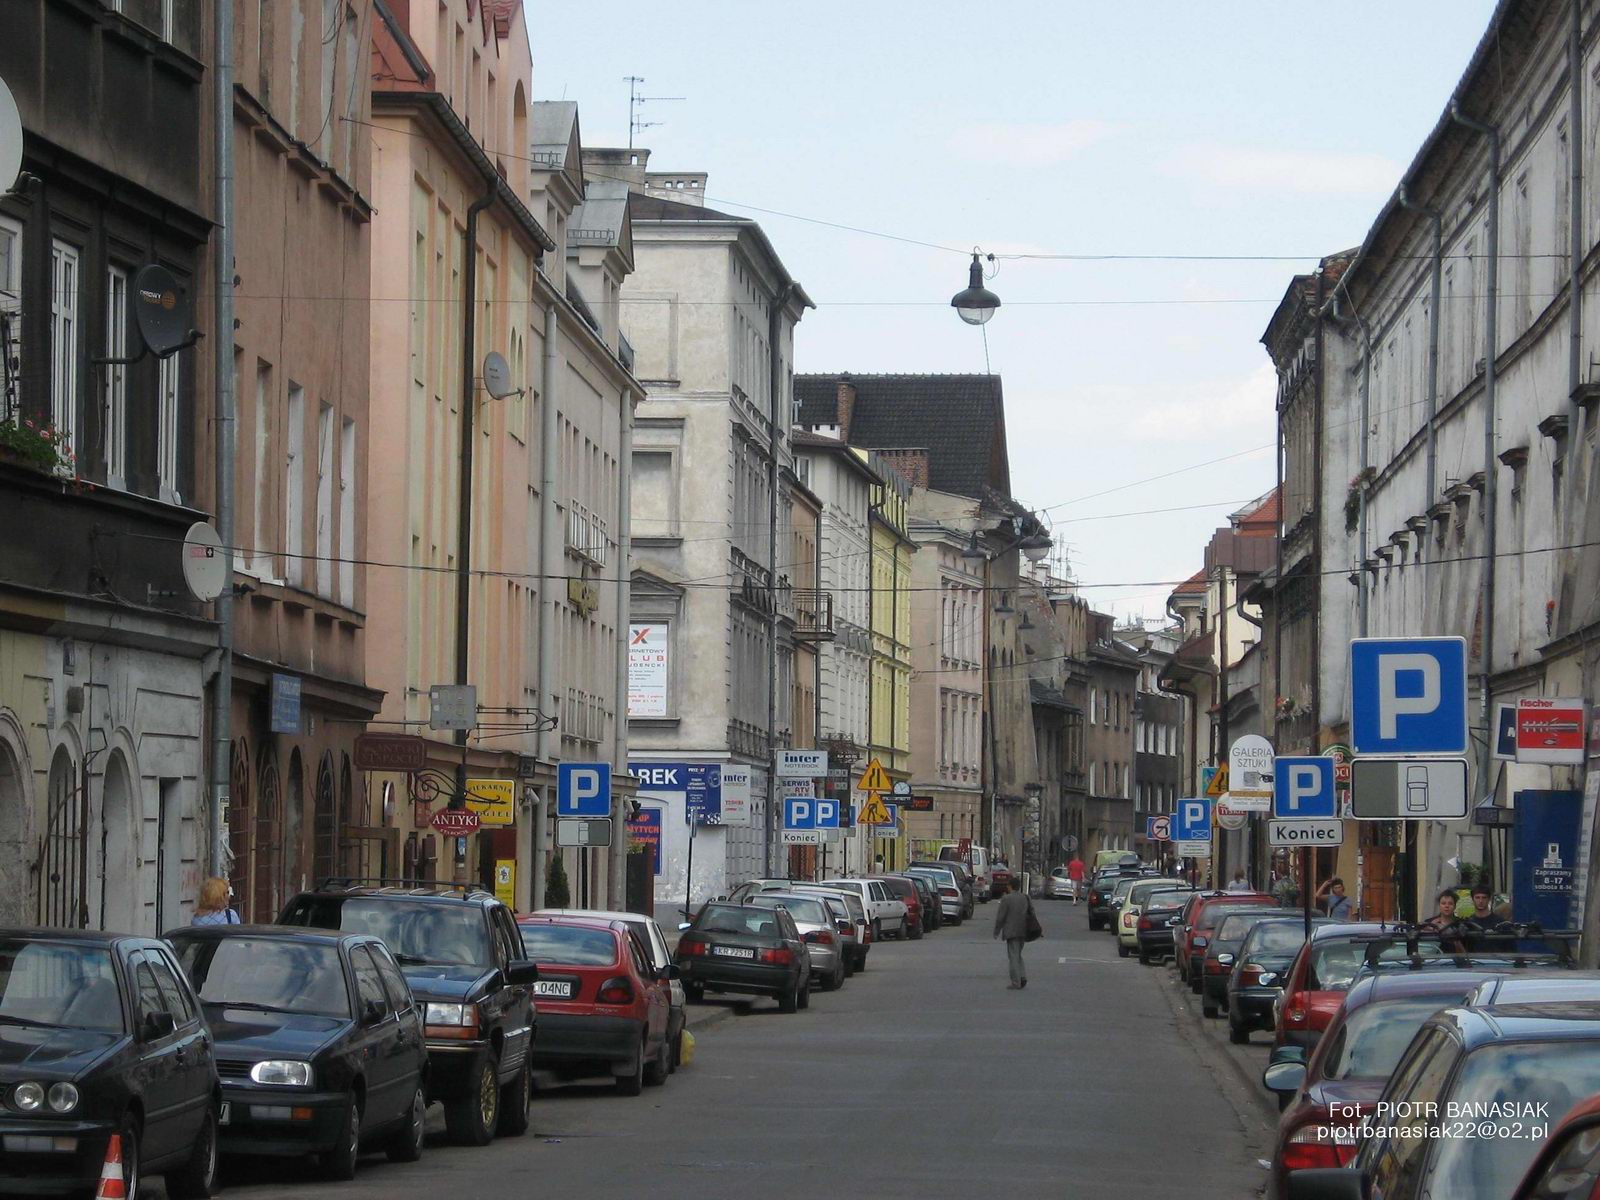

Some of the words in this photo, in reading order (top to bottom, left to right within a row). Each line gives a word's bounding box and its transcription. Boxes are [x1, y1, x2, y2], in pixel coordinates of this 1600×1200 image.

[1379, 653, 1441, 739] P
[1520, 699, 1554, 708] fischer
[784, 752, 820, 763] inter
[1232, 747, 1272, 757] GALERIA
[1237, 759, 1267, 768] SZTUKI
[570, 769, 599, 809] P
[1288, 764, 1322, 809] P
[432, 814, 479, 826] ANTYKI
[791, 802, 810, 826] P
[817, 802, 834, 825] P
[1185, 803, 1204, 829] P
[784, 833, 816, 842] Koniec
[1276, 826, 1335, 840] Koniec
